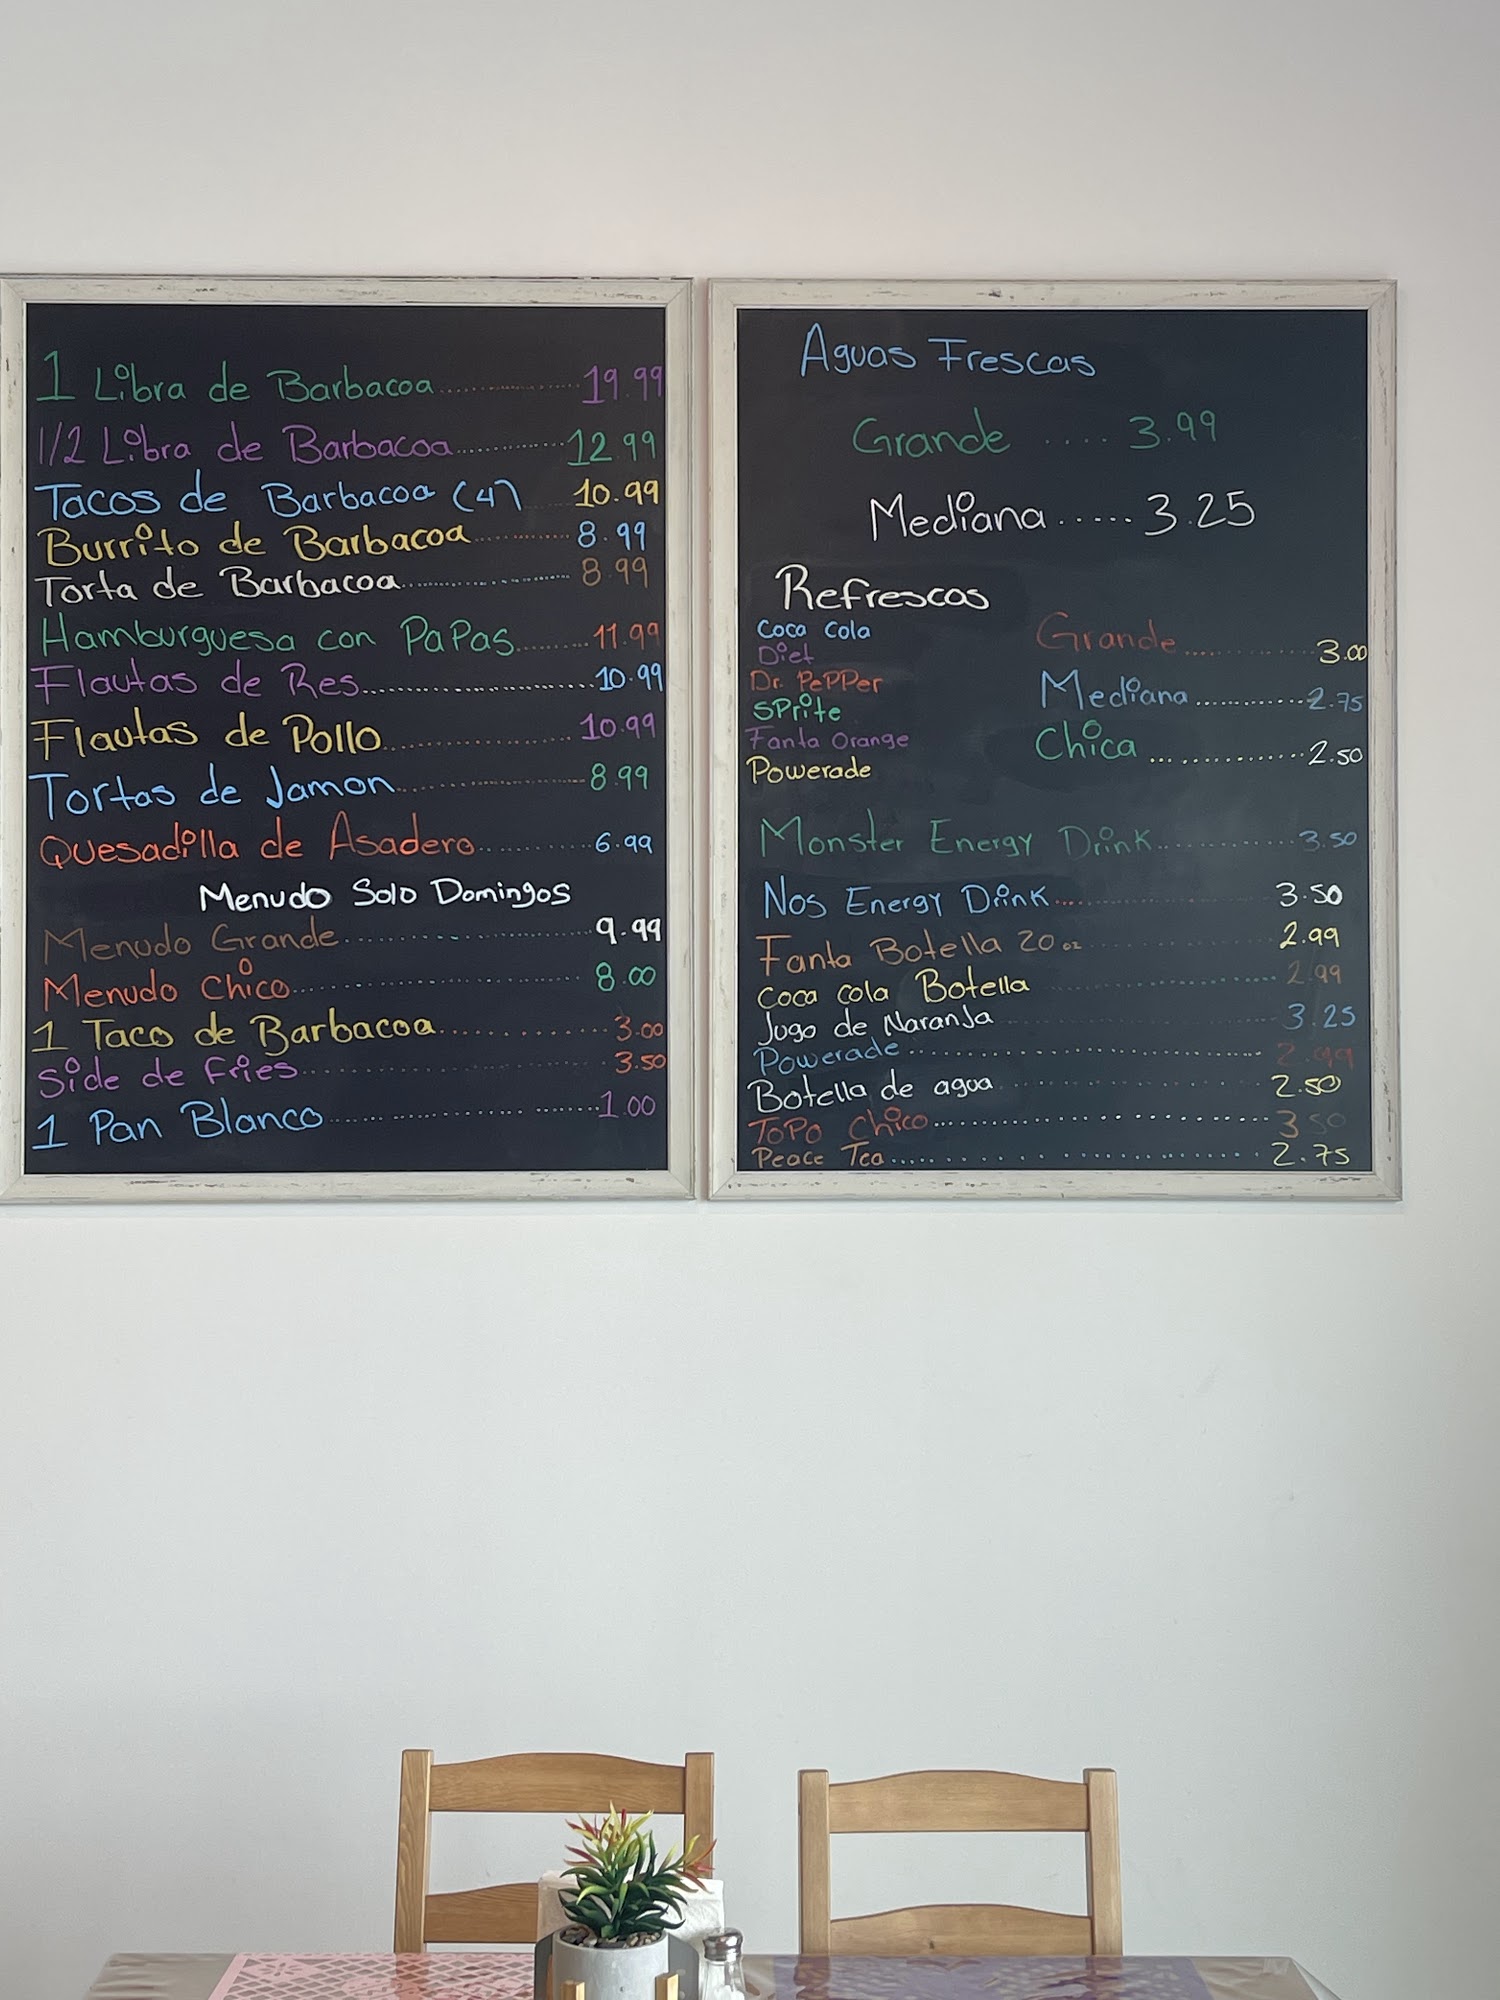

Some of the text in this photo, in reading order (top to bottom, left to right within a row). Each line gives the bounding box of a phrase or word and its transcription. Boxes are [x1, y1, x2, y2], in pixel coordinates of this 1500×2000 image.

[801, 322, 1096, 377] Aguas Frescas
[36, 350, 76, 401] 1
[94, 362, 186, 402] Libra
[208, 360, 250, 402] de
[266, 365, 434, 402] Barbacoa
[39, 421, 85, 466] 1/2
[103, 424, 192, 464] Libra
[217, 421, 264, 462] de
[282, 424, 454, 464] Barbacoa
[853, 407, 1011, 457] Grande
[34, 483, 161, 521] Tacos
[179, 469, 227, 513] de
[260, 481, 436, 518] Barbacoa
[452, 479, 522, 512] (4)
[870, 491, 1047, 542] Mediana
[37, 523, 200, 567] Burrito
[219, 521, 266, 555] de
[282, 524, 471, 562] Barbacoa
[34, 570, 138, 607] Torta
[153, 566, 204, 599] de
[219, 566, 401, 598] Barbacoa
[774, 564, 990, 611] Refrescos
[42, 612, 296, 657] Hamburguesa
[317, 629, 376, 651] con
[759, 642, 815, 665] Diet
[1036, 612, 1177, 652] Grande
[30, 657, 198, 706] Flautas
[220, 658, 262, 698] de
[281, 663, 359, 699] Res
[750, 670, 783, 692] Dr.
[1041, 669, 1189, 710] Mediana
[30, 706, 199, 761] Flautas
[224, 711, 270, 747] de
[282, 714, 382, 755] Pollo
[745, 726, 909, 750] Fanta Orange
[1035, 720, 1137, 761] Chica
[28, 773, 176, 821] Tortas
[200, 762, 242, 805] de
[265, 765, 396, 809] Jamon
[746, 755, 872, 784] Powerade
[40, 822, 240, 870] Quesadilla
[260, 816, 304, 860] de
[329, 810, 476, 861] Asadero
[760, 809, 904, 858] Monster
[199, 878, 571, 912] Menudo Solo Domingos
[764, 875, 827, 919] Nos
[44, 922, 192, 965] Menudo
[211, 915, 339, 952] Grande
[756, 934, 852, 976] Fanta
[869, 929, 1002, 965] Botella
[1017, 930, 1055, 951] 20
[43, 968, 178, 1012] Menudo
[200, 957, 290, 1001] Chico
[914, 966, 1030, 1003] Botella
[31, 1021, 69, 1053] 1
[82, 1019, 174, 1051] Taco
[195, 1011, 236, 1046] de
[250, 1007, 436, 1057] Barbacoa
[758, 1011, 817, 1046] Jugo
[833, 1008, 868, 1039] de
[142, 1057, 184, 1087] de
[753, 1037, 900, 1076] Powerade
[747, 1074, 868, 1113] Botella
[880, 1069, 913, 1100] de
[934, 1075, 994, 1098] agua
[31, 1114, 69, 1150] 1
[89, 1109, 163, 1146] Pan
[180, 1097, 323, 1138] Blanco
[850, 1106, 929, 1141] Chico
[752, 1147, 824, 1169] Peace
[841, 1141, 885, 1168] Tea
